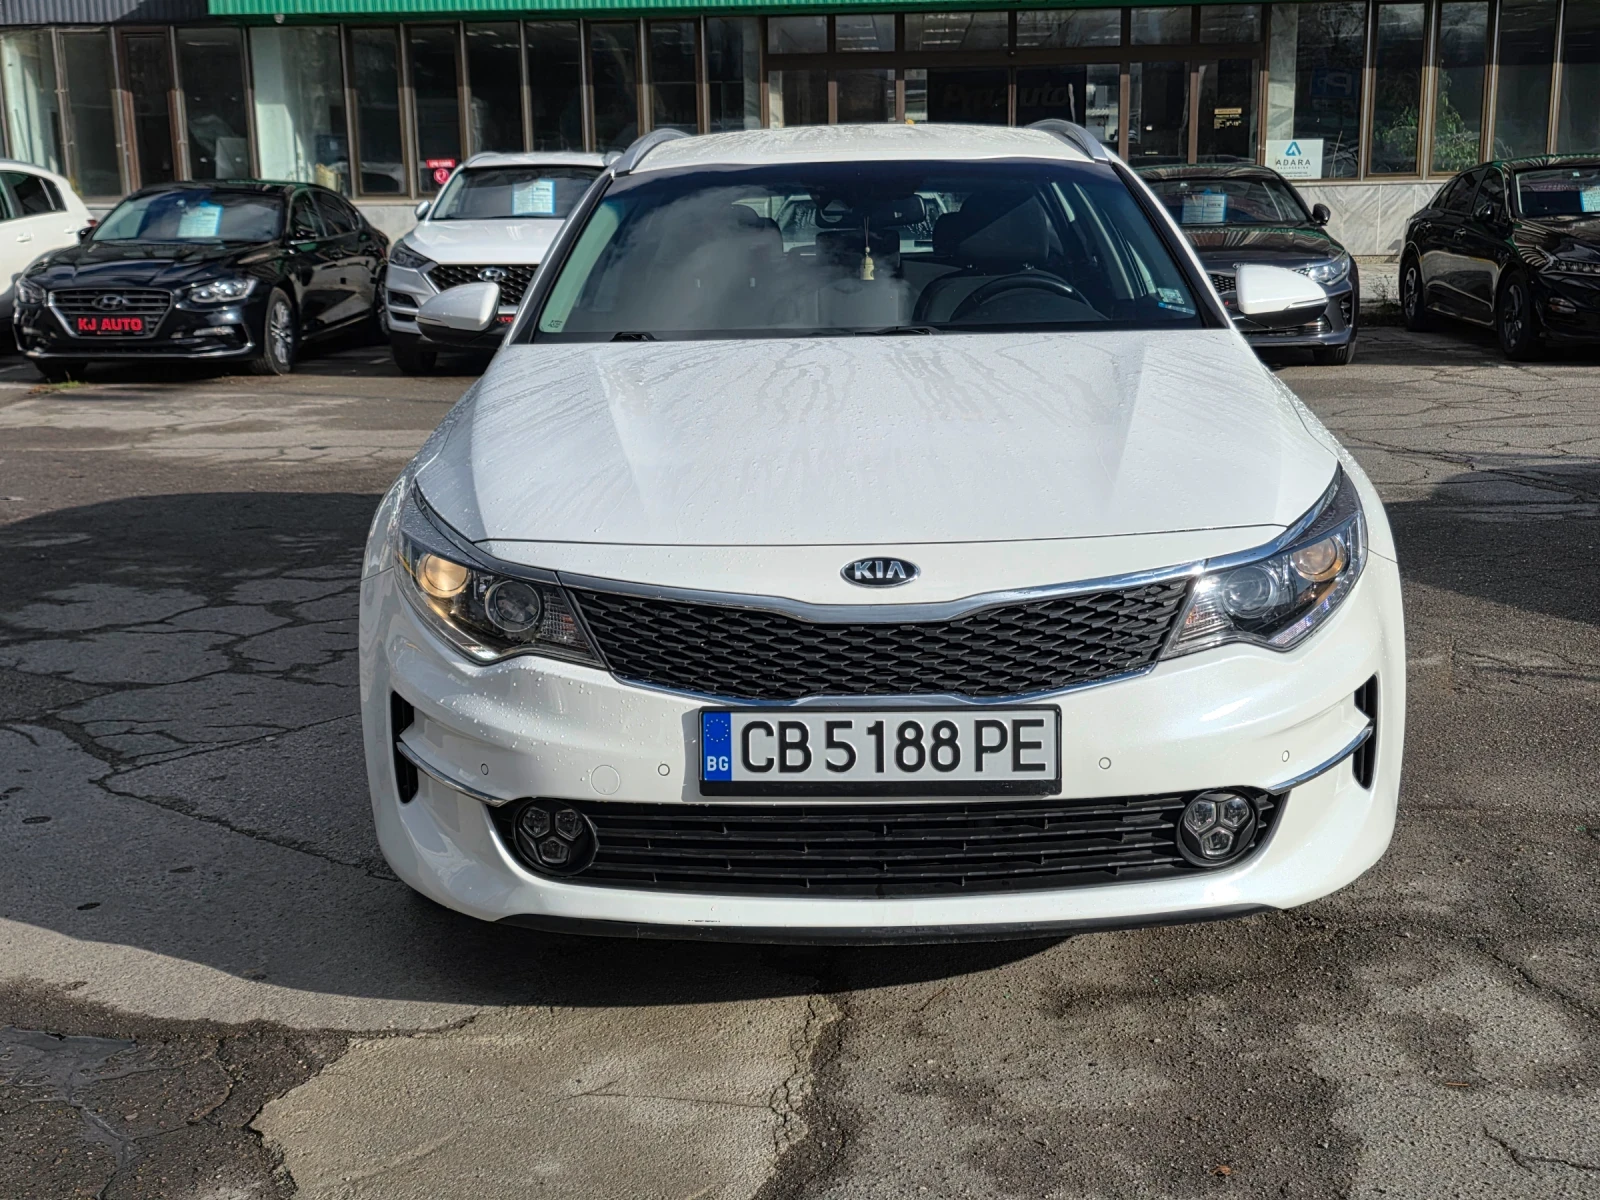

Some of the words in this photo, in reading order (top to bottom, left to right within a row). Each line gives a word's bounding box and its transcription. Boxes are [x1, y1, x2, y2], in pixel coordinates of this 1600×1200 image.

[78, 317, 97, 331] KJ
[101, 317, 142, 331] AUTO
[854, 560, 907, 580] KIA
[741, 720, 813, 774] CB
[825, 719, 961, 774] 5188
[974, 718, 1046, 773] PE
[706, 755, 729, 772] BG
